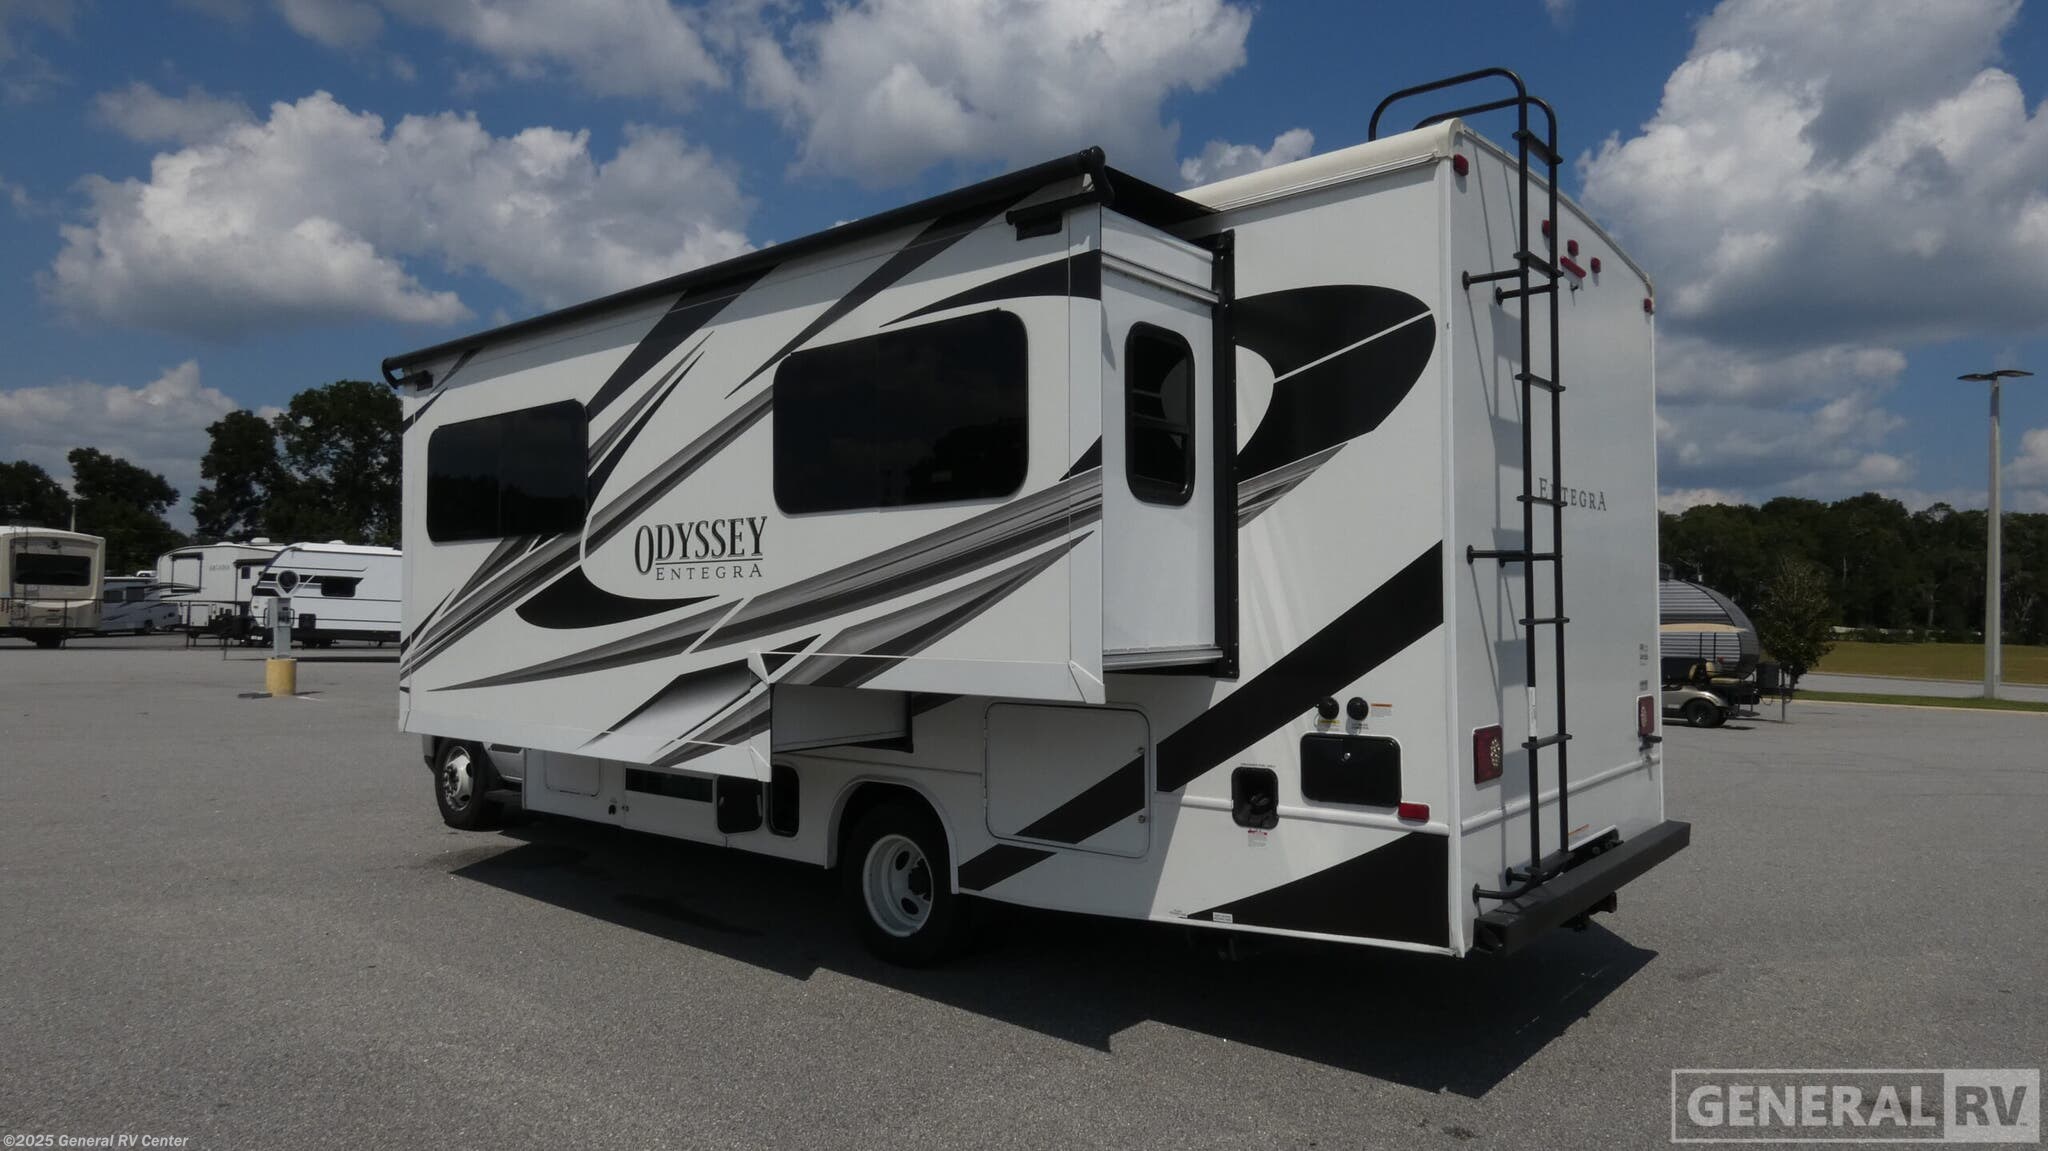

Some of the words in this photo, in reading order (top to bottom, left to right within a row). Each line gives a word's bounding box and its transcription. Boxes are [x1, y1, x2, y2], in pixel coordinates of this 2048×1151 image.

[1538, 477, 1607, 511] ETEGRA
[634, 516, 768, 575] ODYSSEY
[656, 563, 762, 581] ENTEGRA
